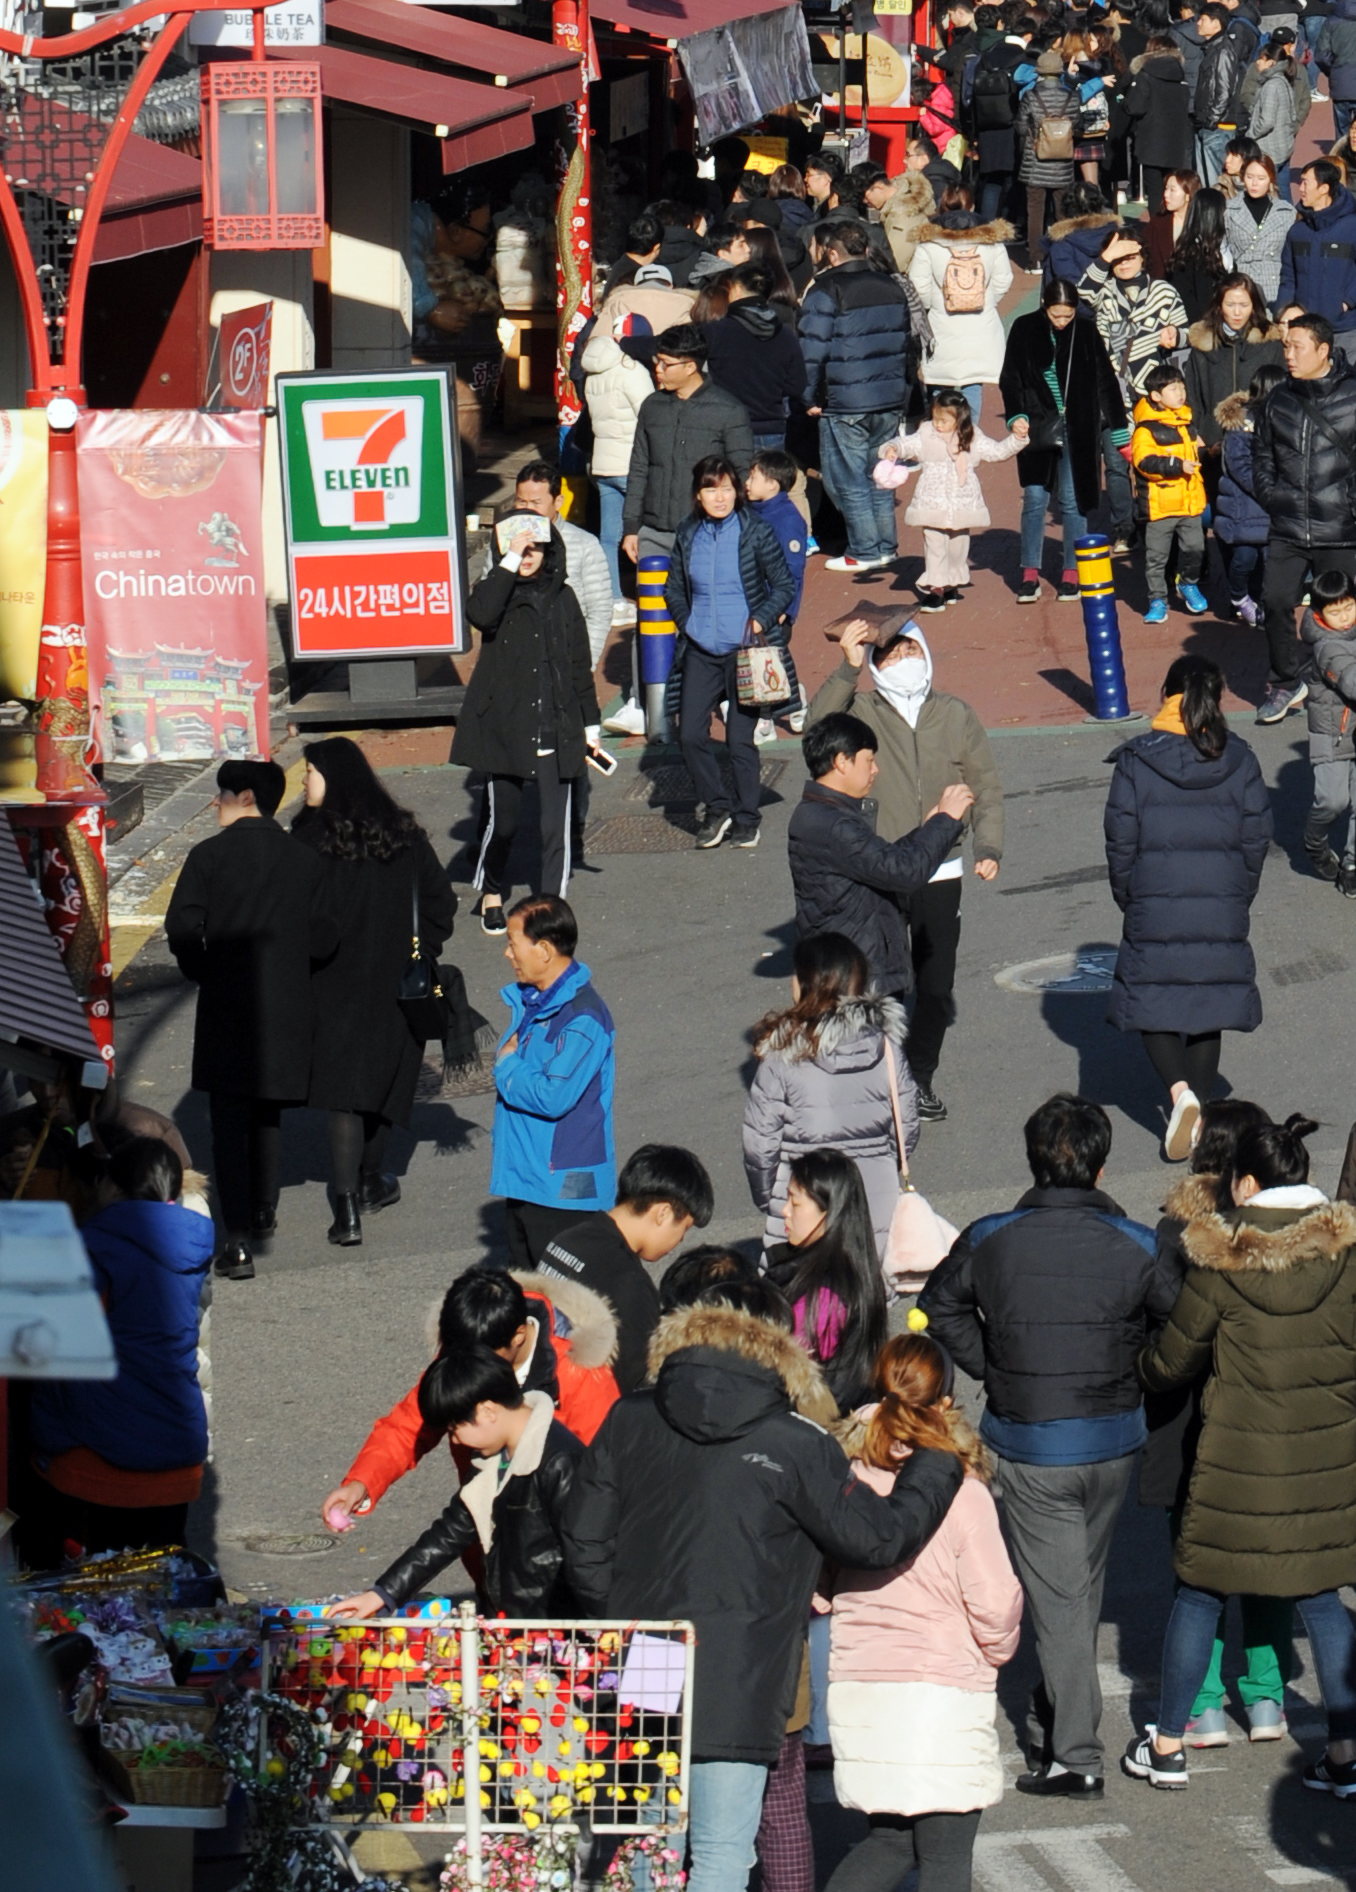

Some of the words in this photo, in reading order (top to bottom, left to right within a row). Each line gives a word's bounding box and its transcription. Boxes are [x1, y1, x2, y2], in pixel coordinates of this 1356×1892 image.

[225, 13, 282, 26] BUBLE
[287, 13, 315, 26] TEA
[234, 342, 252, 381] 2F
[94, 568, 256, 599] Chinatown
[299, 581, 451, 620] 24시간편의점
